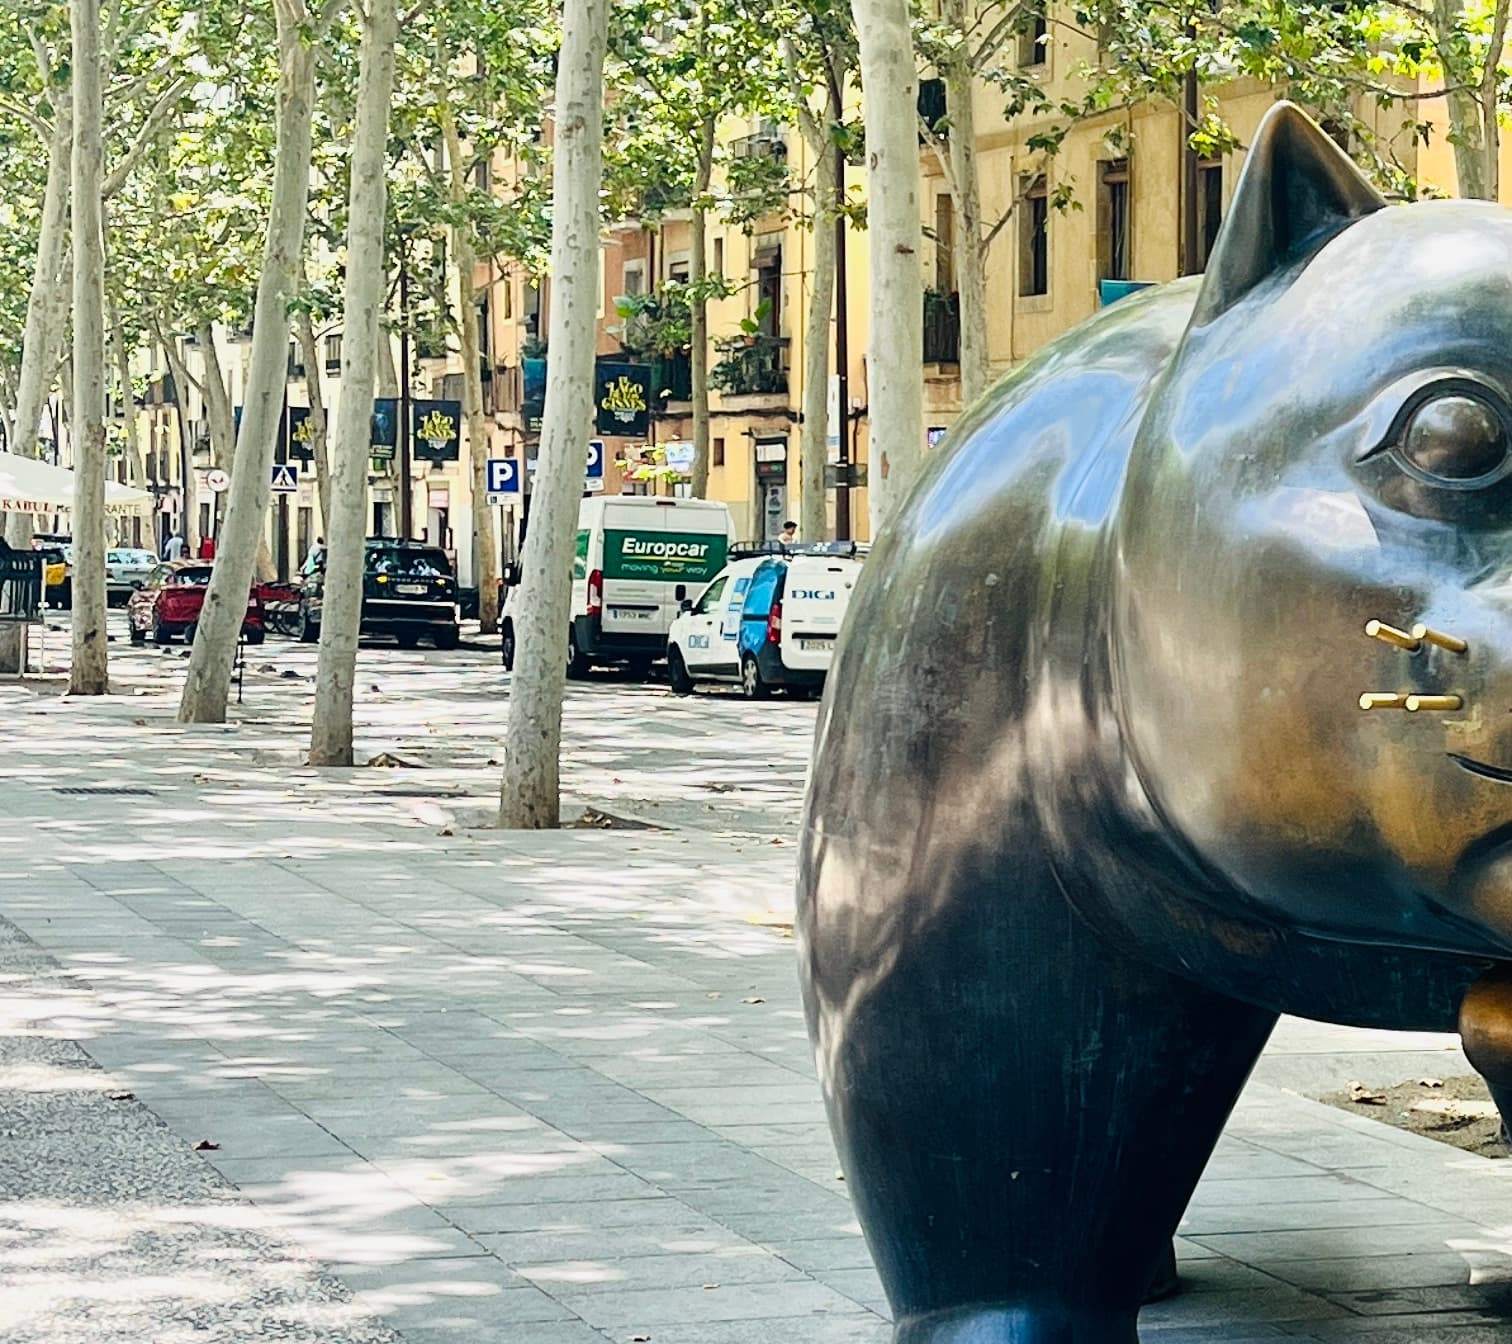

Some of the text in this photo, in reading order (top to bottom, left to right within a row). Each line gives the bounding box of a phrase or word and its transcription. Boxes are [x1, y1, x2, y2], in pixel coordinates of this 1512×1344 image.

[492, 462, 513, 489] P
[621, 537, 709, 560] Europcar
[621, 563, 658, 574] moving
[686, 567, 708, 576] way
[791, 590, 835, 599] DIGI
[688, 635, 709, 648] DIGI
